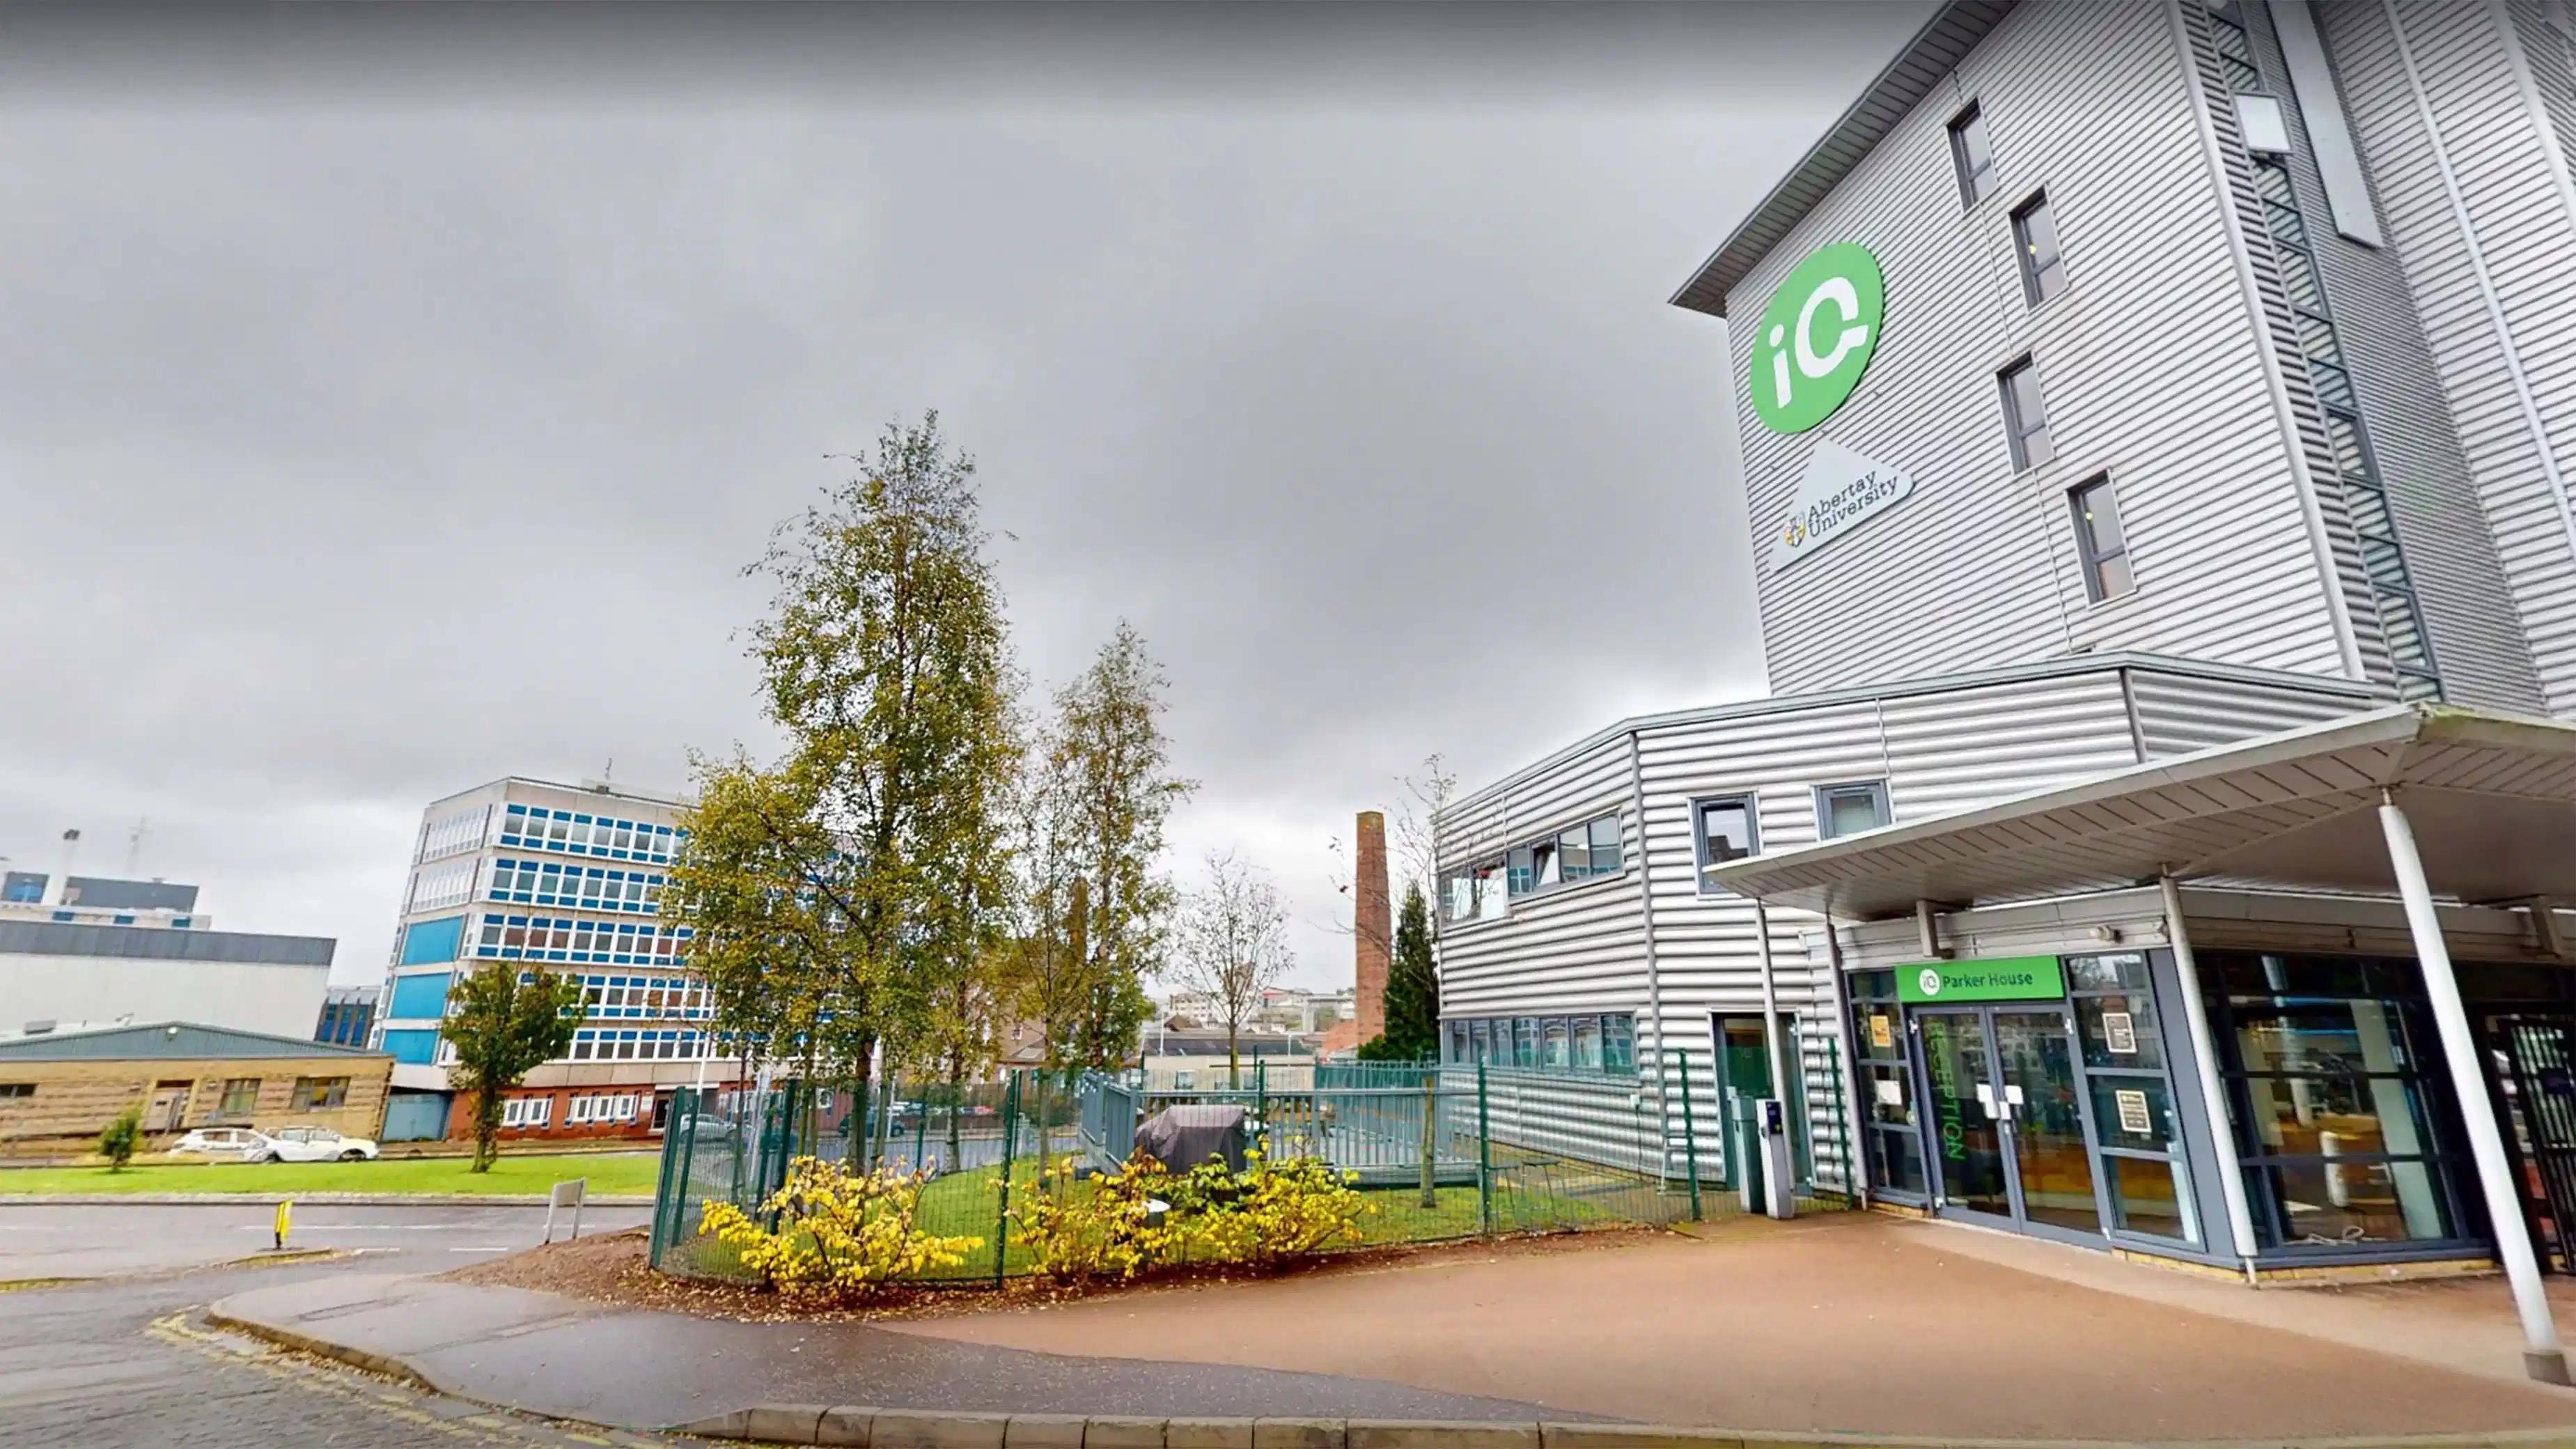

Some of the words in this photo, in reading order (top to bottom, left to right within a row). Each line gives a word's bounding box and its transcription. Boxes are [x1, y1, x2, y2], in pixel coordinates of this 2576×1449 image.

[1809, 470, 1876, 522] Abertay
[1809, 476, 1898, 538] University
[1942, 974, 1986, 988] Parker
[1988, 973, 2034, 987] House
[1929, 1022, 1967, 1161] RECEPTION
